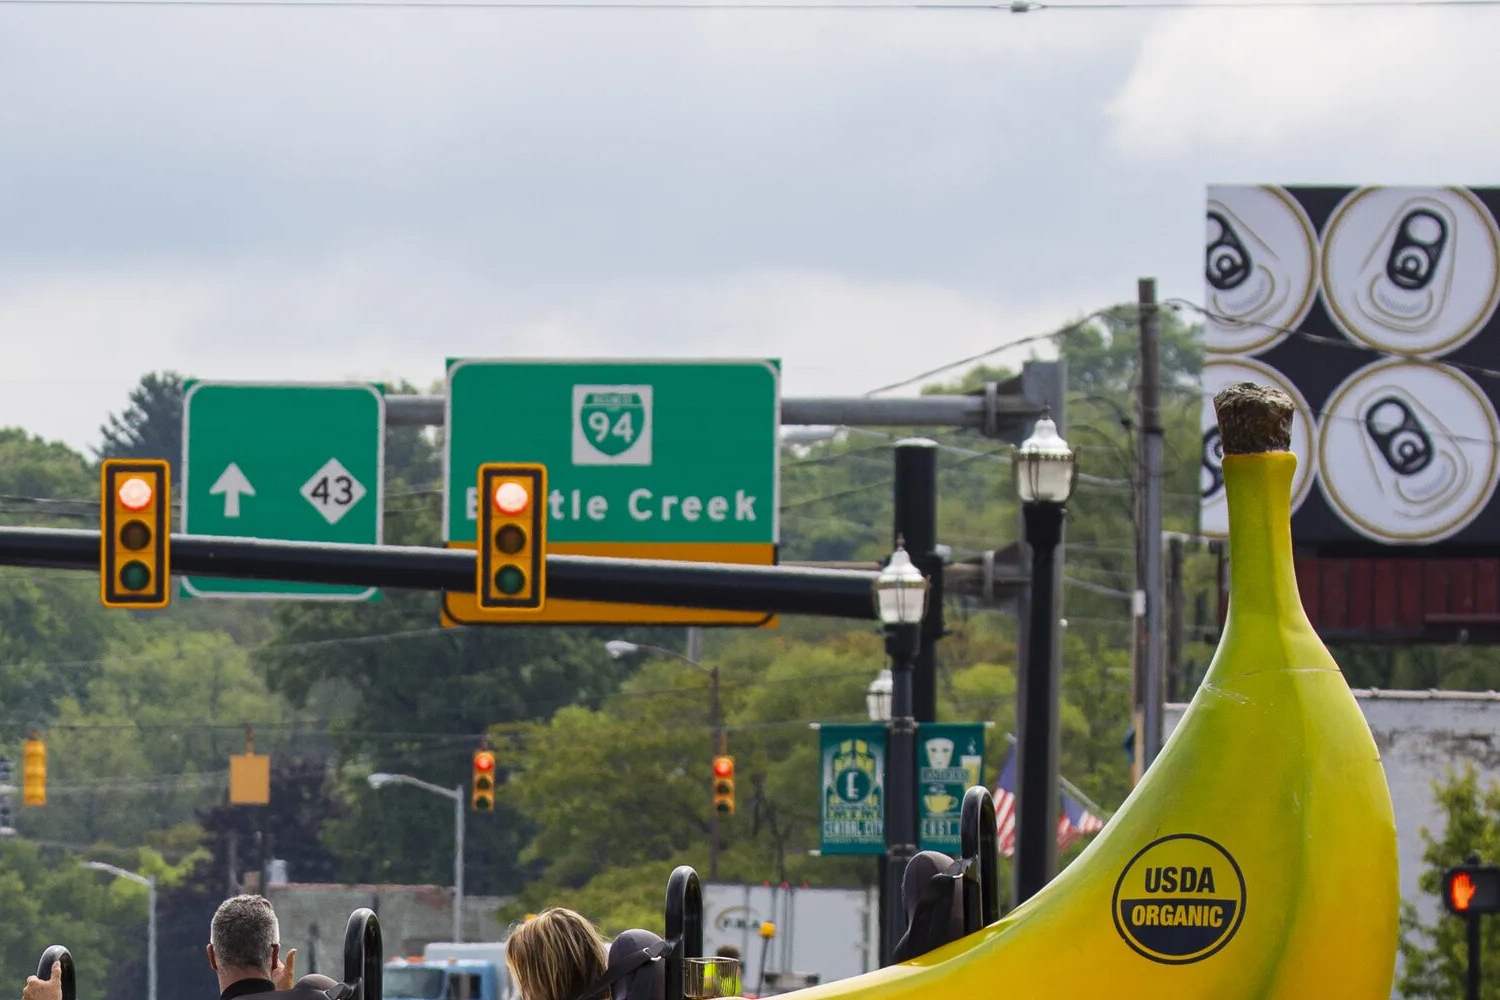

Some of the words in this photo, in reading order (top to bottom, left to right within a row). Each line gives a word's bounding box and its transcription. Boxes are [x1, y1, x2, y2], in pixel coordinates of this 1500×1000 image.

[588, 411, 634, 443] 94
[311, 475, 353, 505] 43
[628, 488, 756, 521] Creek
[1145, 867, 1215, 893] USDA
[1132, 905, 1223, 927] ORGANIC
